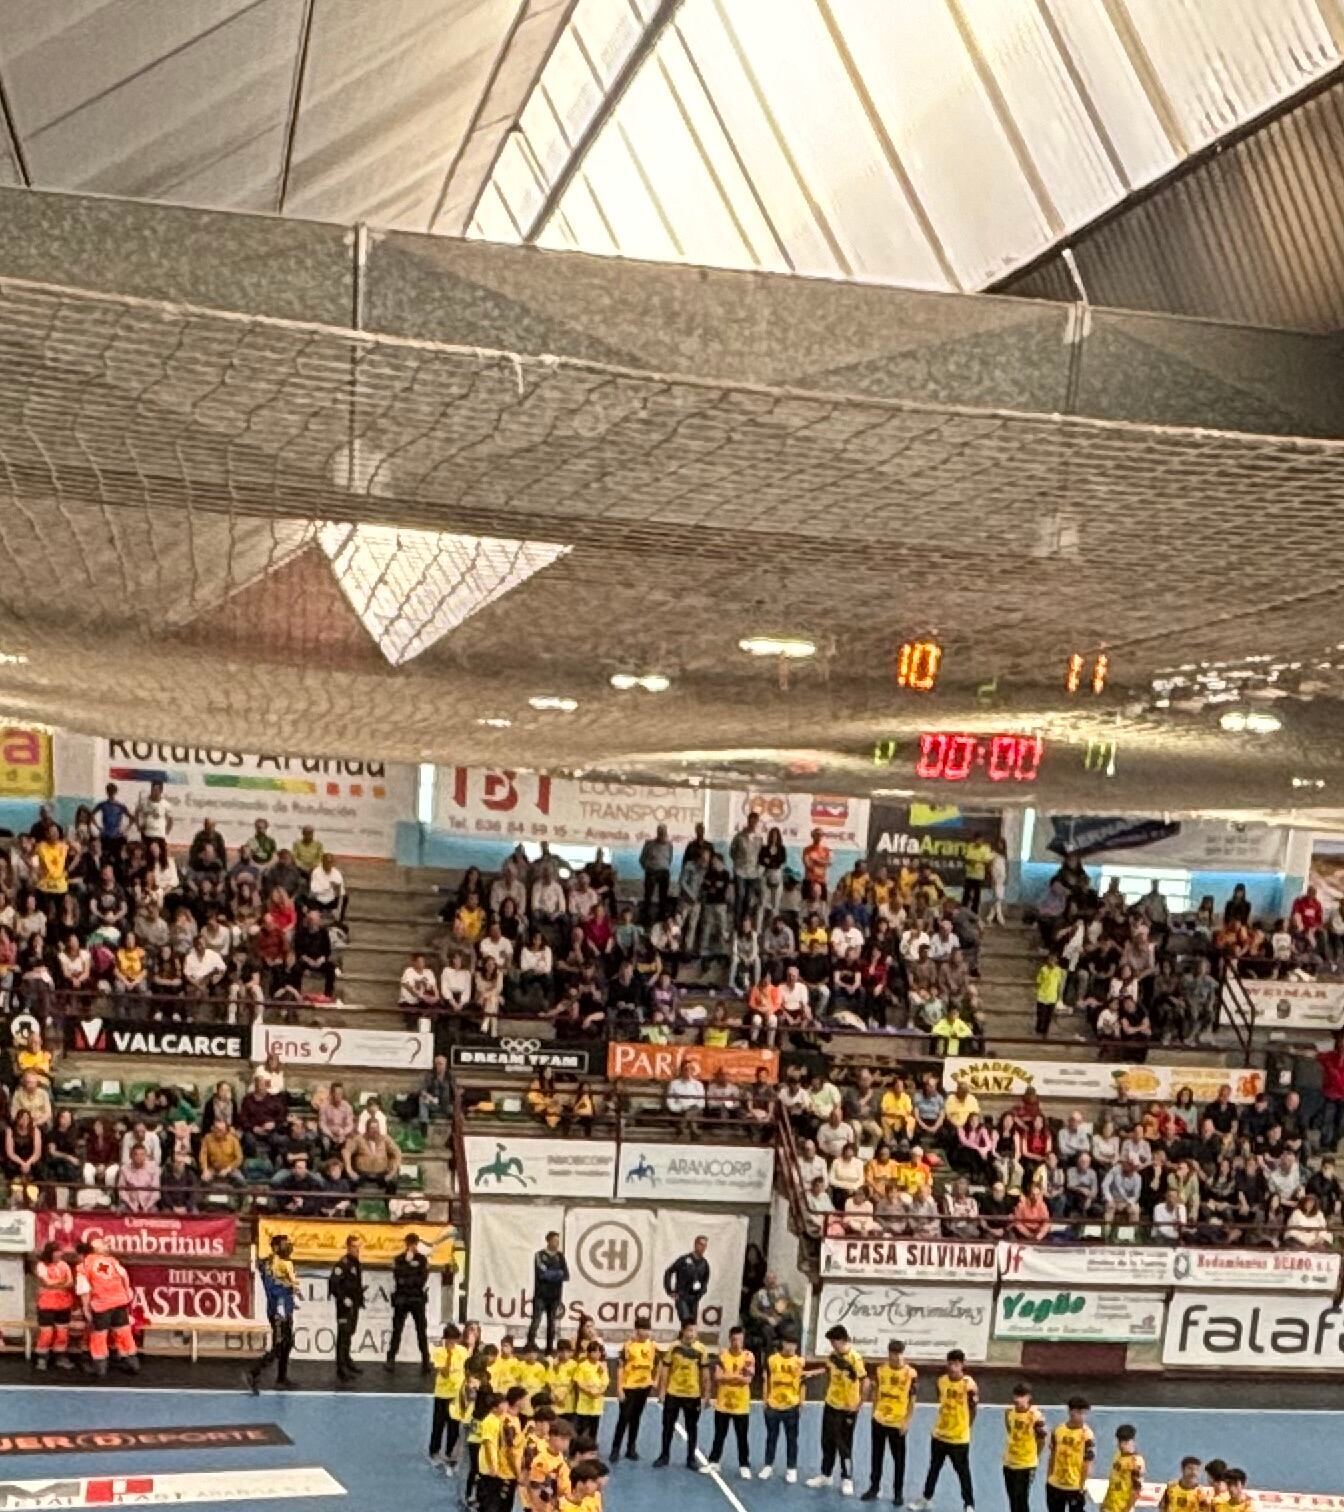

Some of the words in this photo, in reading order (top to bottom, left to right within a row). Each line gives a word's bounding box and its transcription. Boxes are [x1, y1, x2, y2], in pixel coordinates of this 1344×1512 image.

[115, 1031, 241, 1058] VALCARCE
[81, 1225, 224, 1257] Gambrinus
[846, 1243, 898, 1265] CASA
[907, 1244, 996, 1268] SILVIANO
[131, 1287, 243, 1319] ASTOR
[597, 1299, 723, 1327] arana
